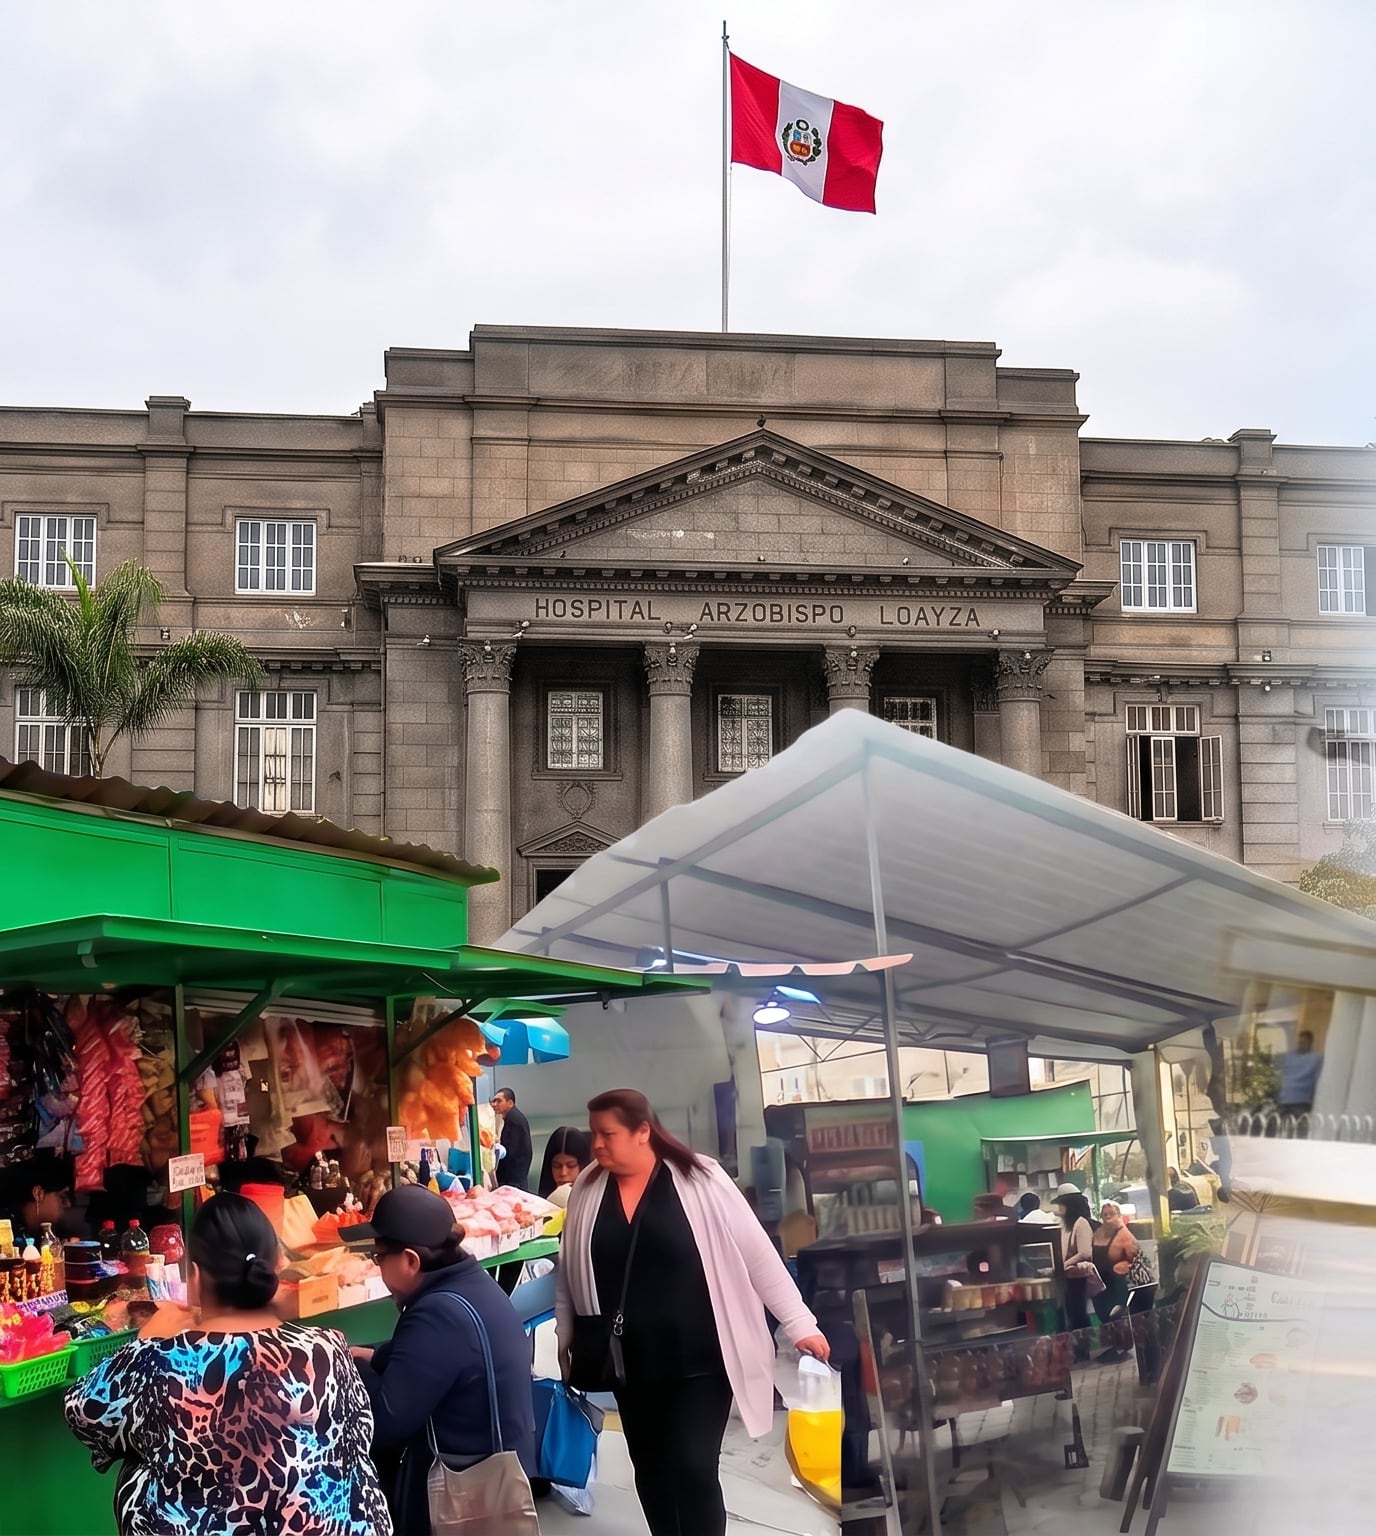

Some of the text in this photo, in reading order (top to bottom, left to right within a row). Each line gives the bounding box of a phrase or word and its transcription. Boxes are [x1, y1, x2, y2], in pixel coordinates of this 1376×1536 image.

[534, 597, 981, 628] HOSPITAL ARZOBISPO LOAYZA
